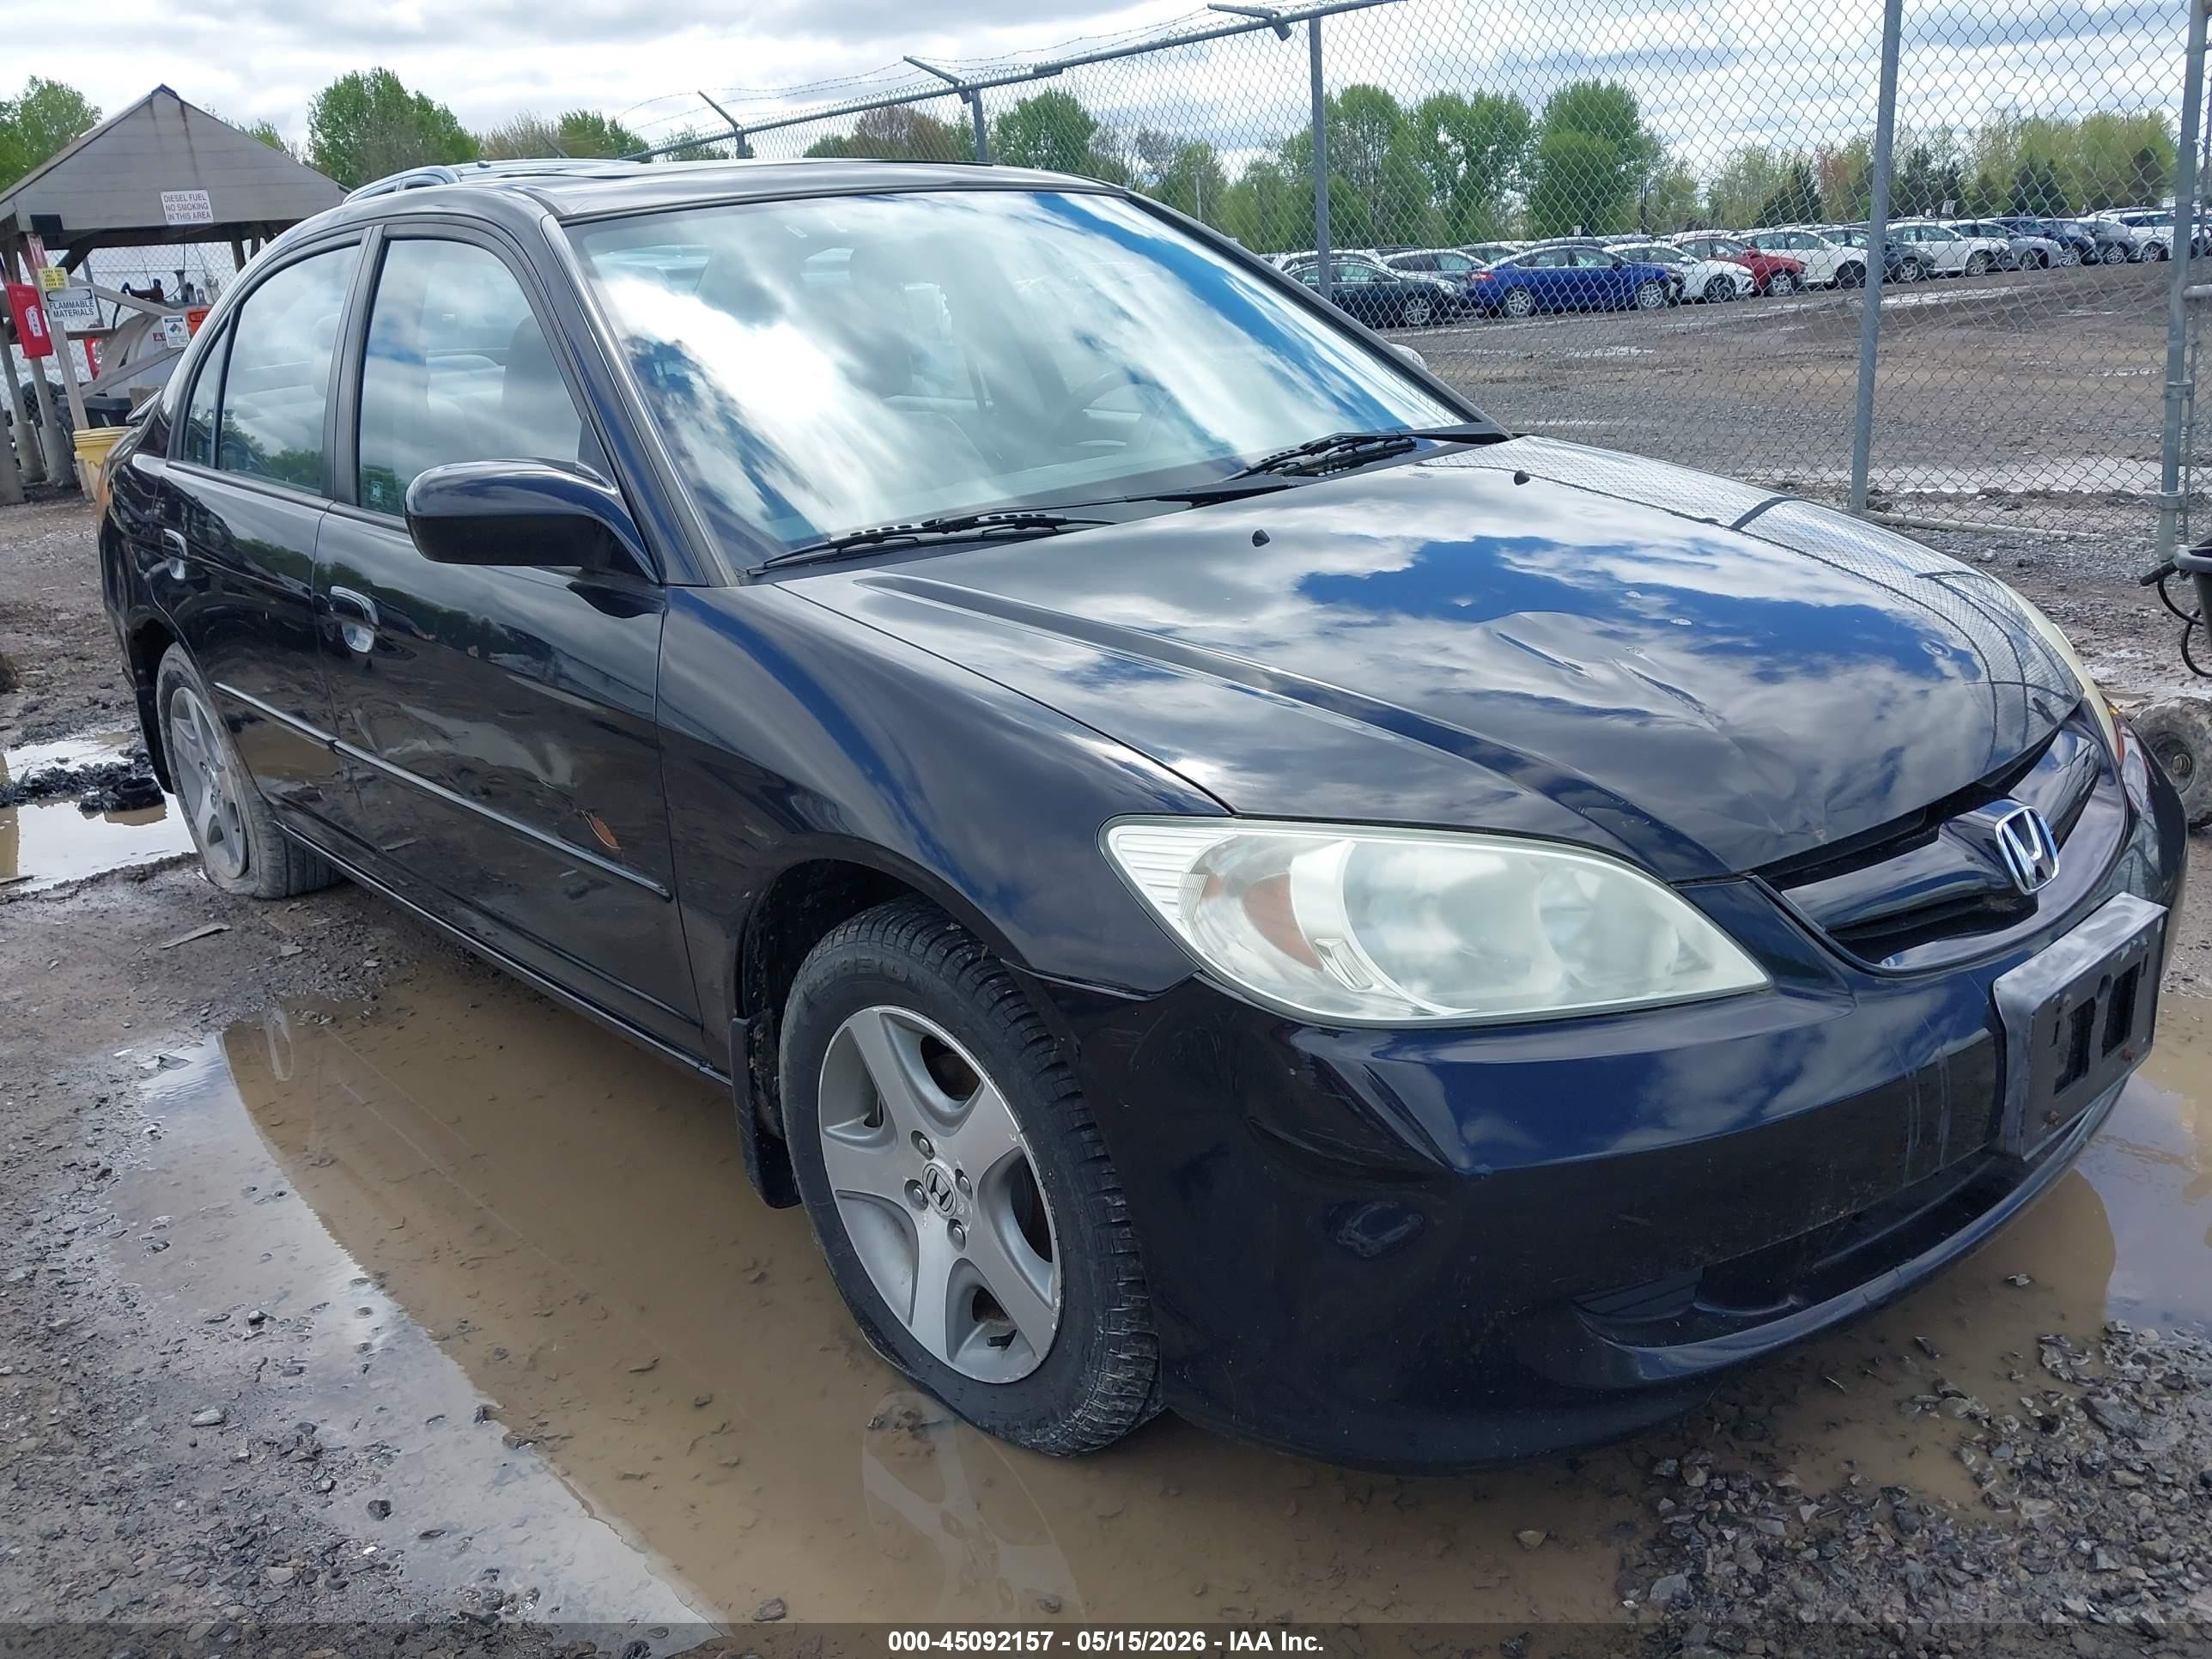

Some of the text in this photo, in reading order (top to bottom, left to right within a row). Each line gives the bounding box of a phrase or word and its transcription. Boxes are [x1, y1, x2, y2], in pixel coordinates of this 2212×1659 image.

[163, 194, 188, 203] DIESEL
[192, 211, 211, 220] AREA
[49, 300, 94, 310] FLAMMABLE
[52, 308, 94, 318] MATERIALS
